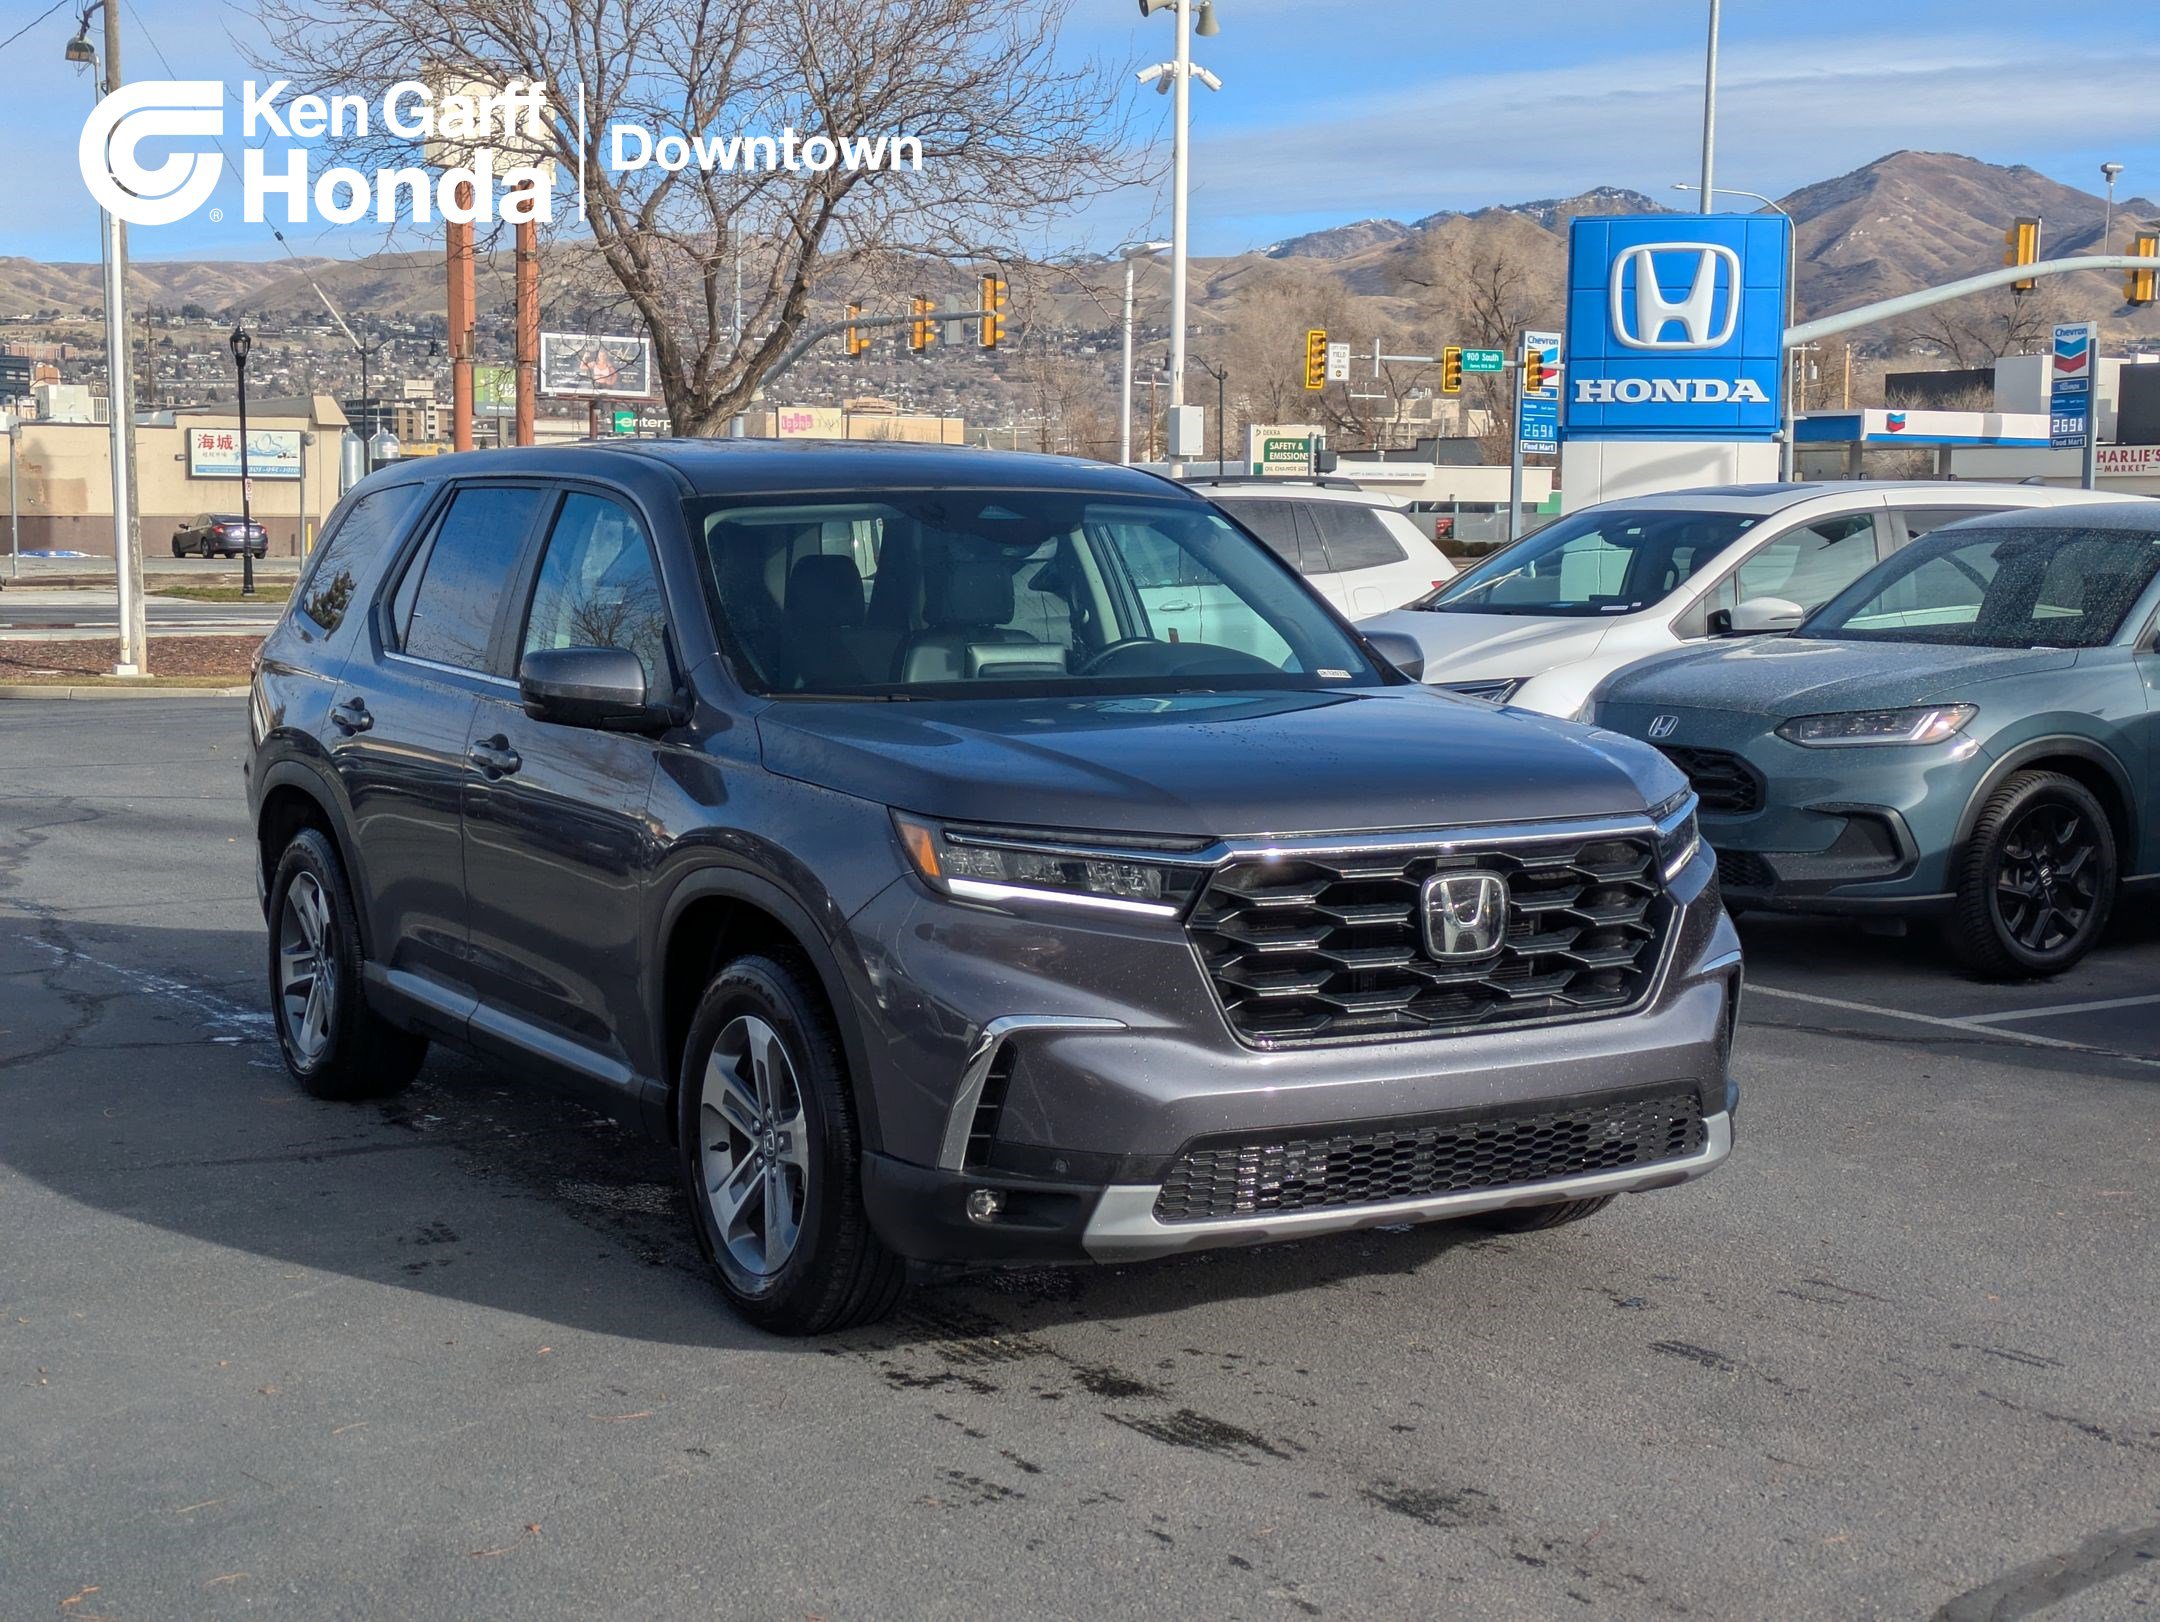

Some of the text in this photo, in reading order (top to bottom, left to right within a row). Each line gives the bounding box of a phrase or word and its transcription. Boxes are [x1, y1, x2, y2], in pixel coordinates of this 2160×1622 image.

[2055, 327, 2088, 337] Chevron
[1527, 335, 1559, 345] Chevron
[1466, 352, 1499, 362] 900 South
[1575, 378, 1770, 403] HONDA
[620, 416, 672, 431] enterp
[197, 433, 234, 450] 海城
[1269, 441, 1304, 450] SAFETY &
[1539, 443, 1554, 451] Mart
[2096, 449, 2160, 463] HARLIE'S
[2104, 464, 2146, 472] MARKET
